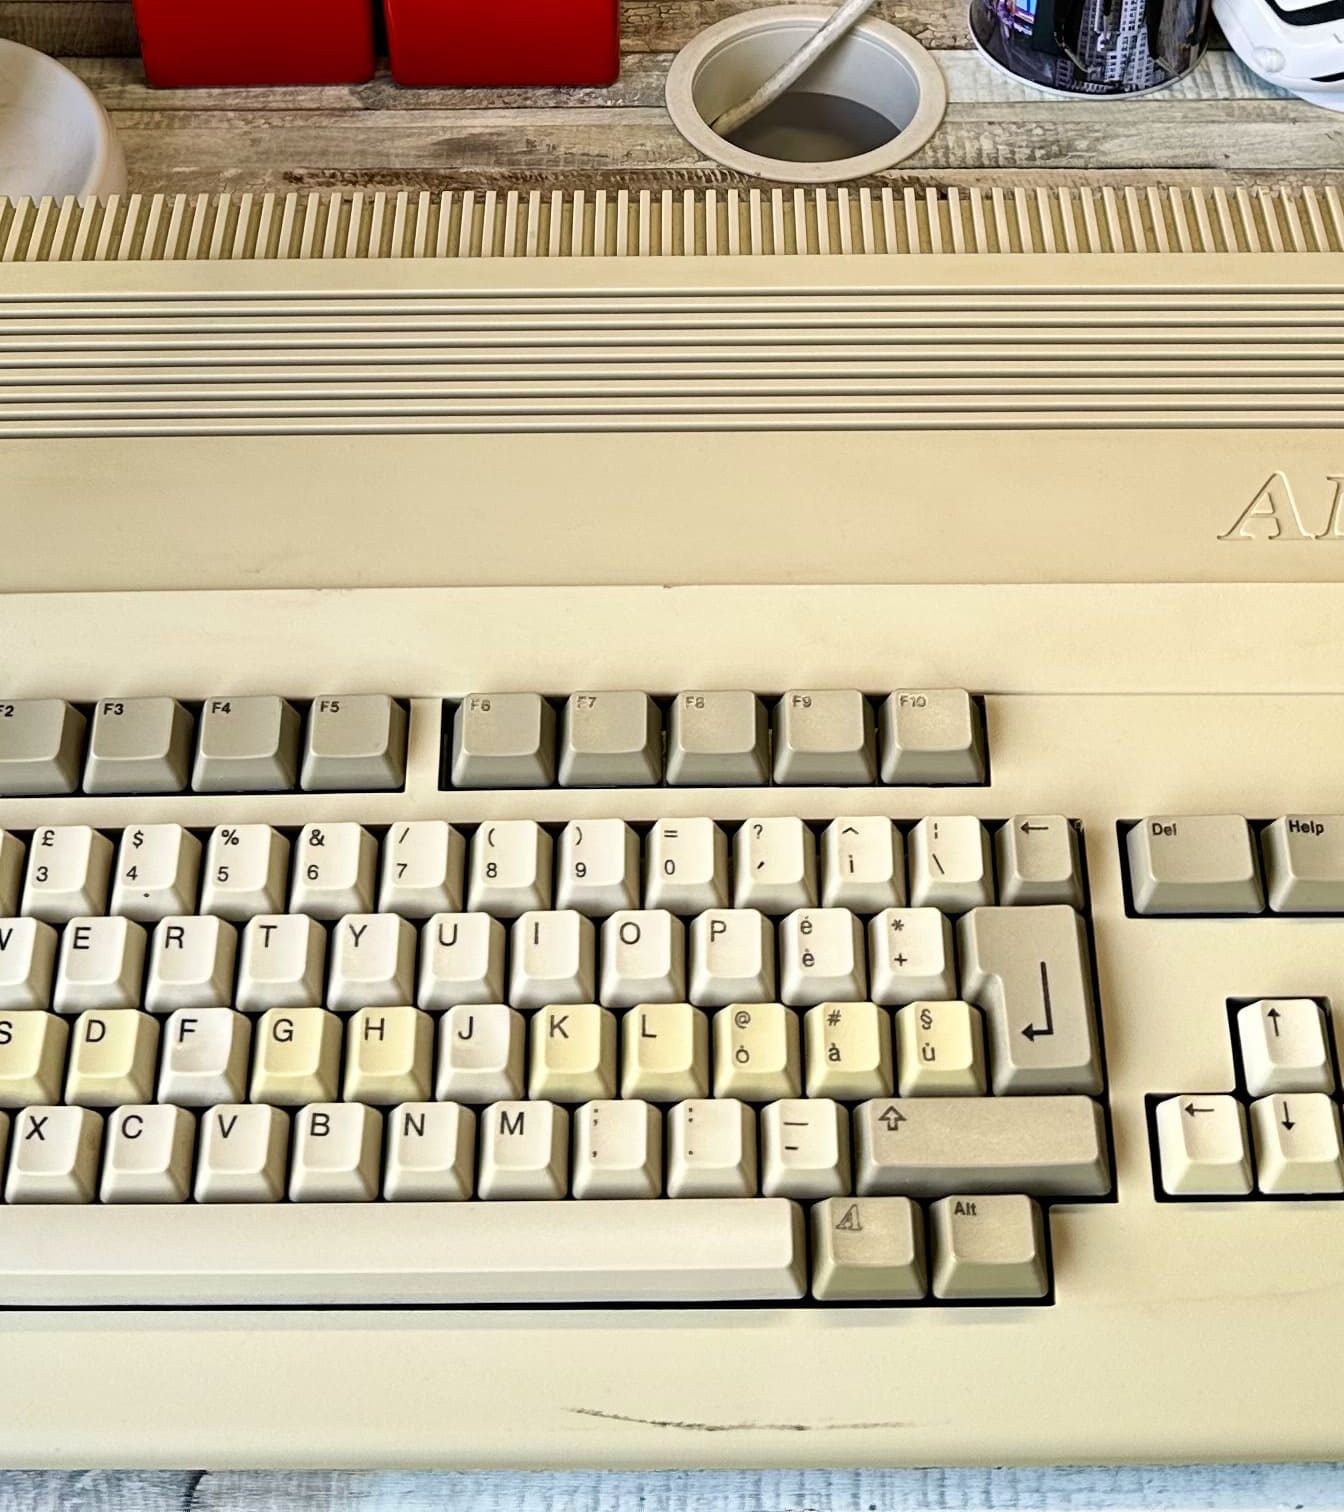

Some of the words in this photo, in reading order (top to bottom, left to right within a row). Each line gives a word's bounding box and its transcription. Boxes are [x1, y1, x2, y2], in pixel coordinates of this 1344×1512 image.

[212, 701, 232, 715] F4
[320, 701, 340, 715] F5
[470, 698, 492, 713] F6
[577, 696, 597, 710] F7
[686, 695, 705, 709] F8
[792, 695, 813, 709] F9
[899, 695, 927, 709] F10
[103, 703, 124, 717] F3
[1152, 822, 1177, 837] Del
[1288, 820, 1324, 836] Help
[73, 927, 91, 950] E
[165, 926, 185, 949] R
[259, 925, 278, 948] T
[349, 924, 368, 948] Y
[438, 923, 458, 947] U
[619, 922, 640, 946] O
[710, 920, 727, 943] P
[953, 1201, 977, 1217] Alt
